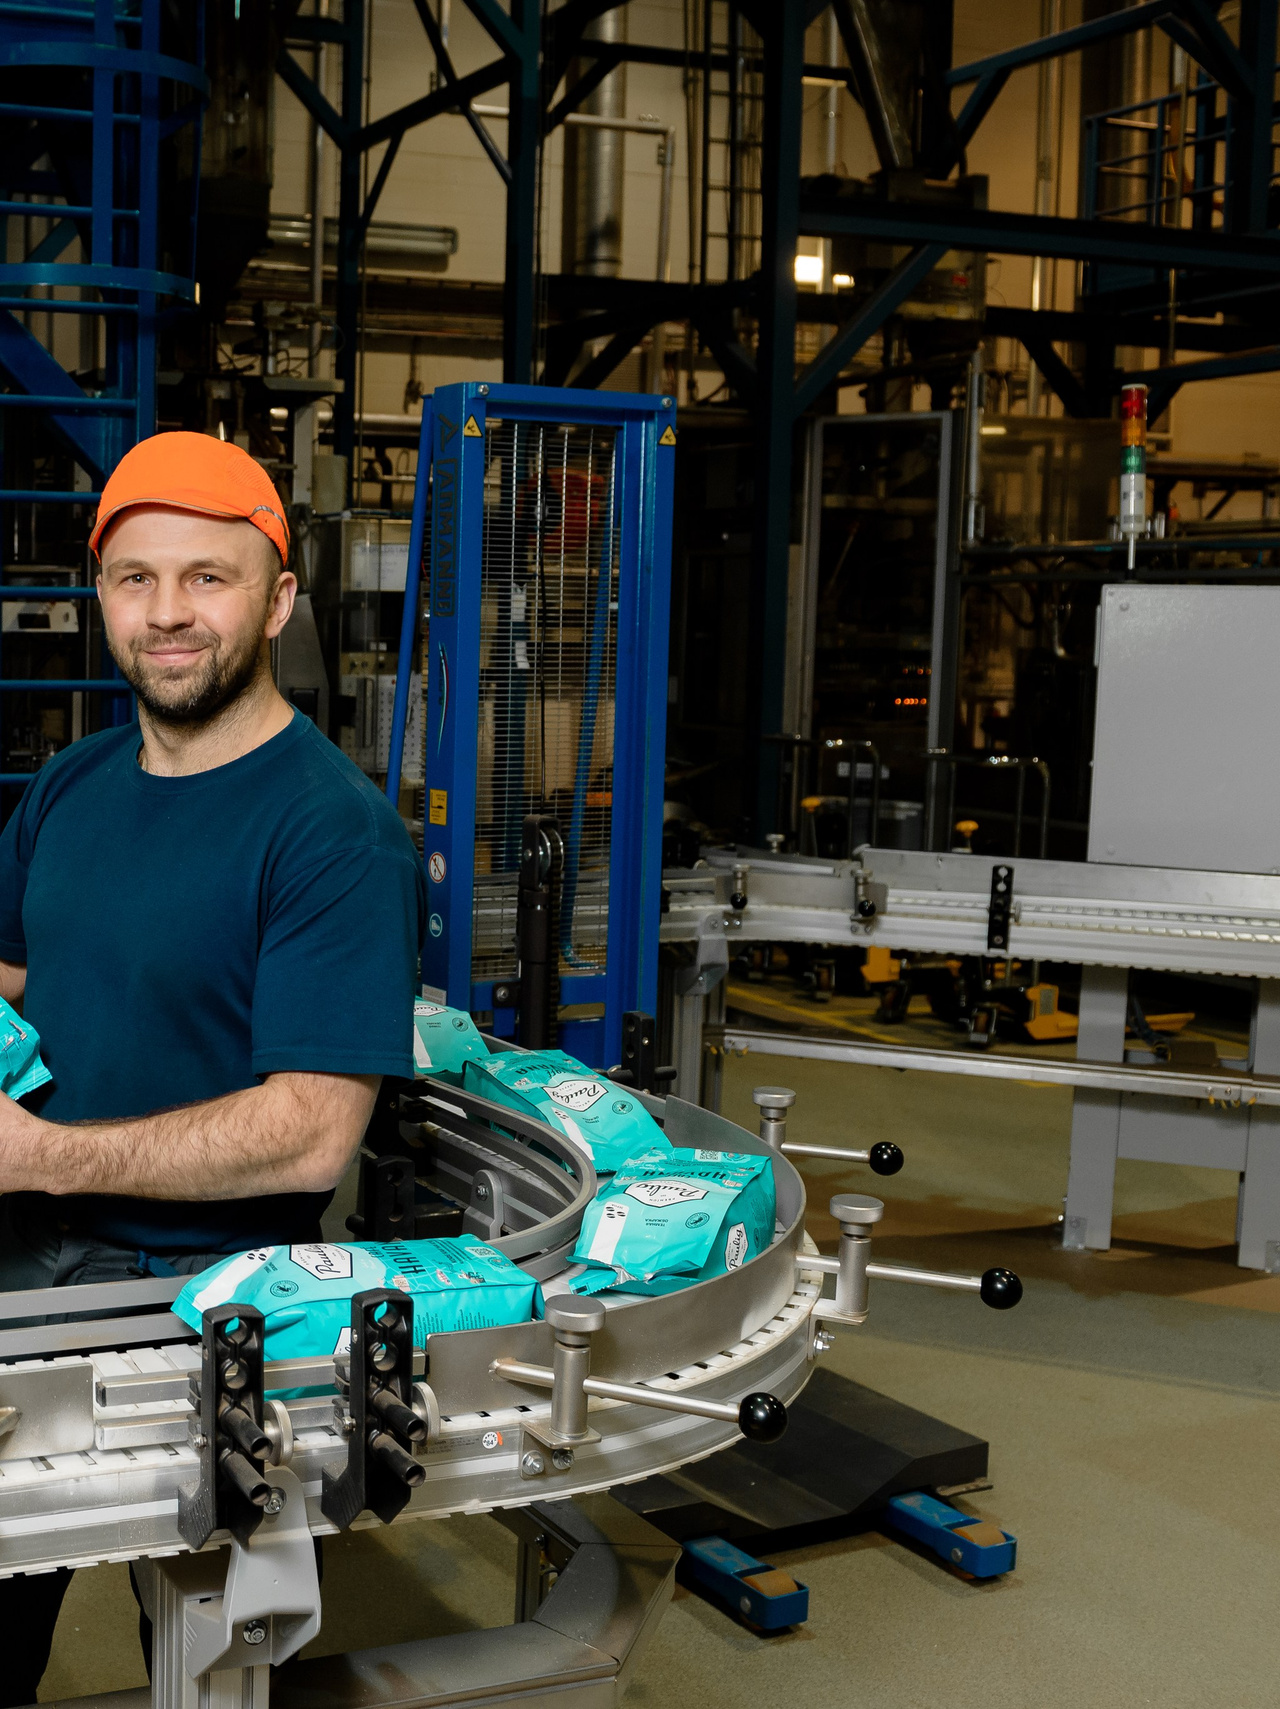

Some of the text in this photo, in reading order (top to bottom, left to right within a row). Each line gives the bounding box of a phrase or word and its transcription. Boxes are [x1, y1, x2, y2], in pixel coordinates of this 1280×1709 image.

[549, 1084, 600, 1104] Paulig
[636, 1182, 700, 1197] Paulig
[729, 1229, 744, 1269] Paulig
